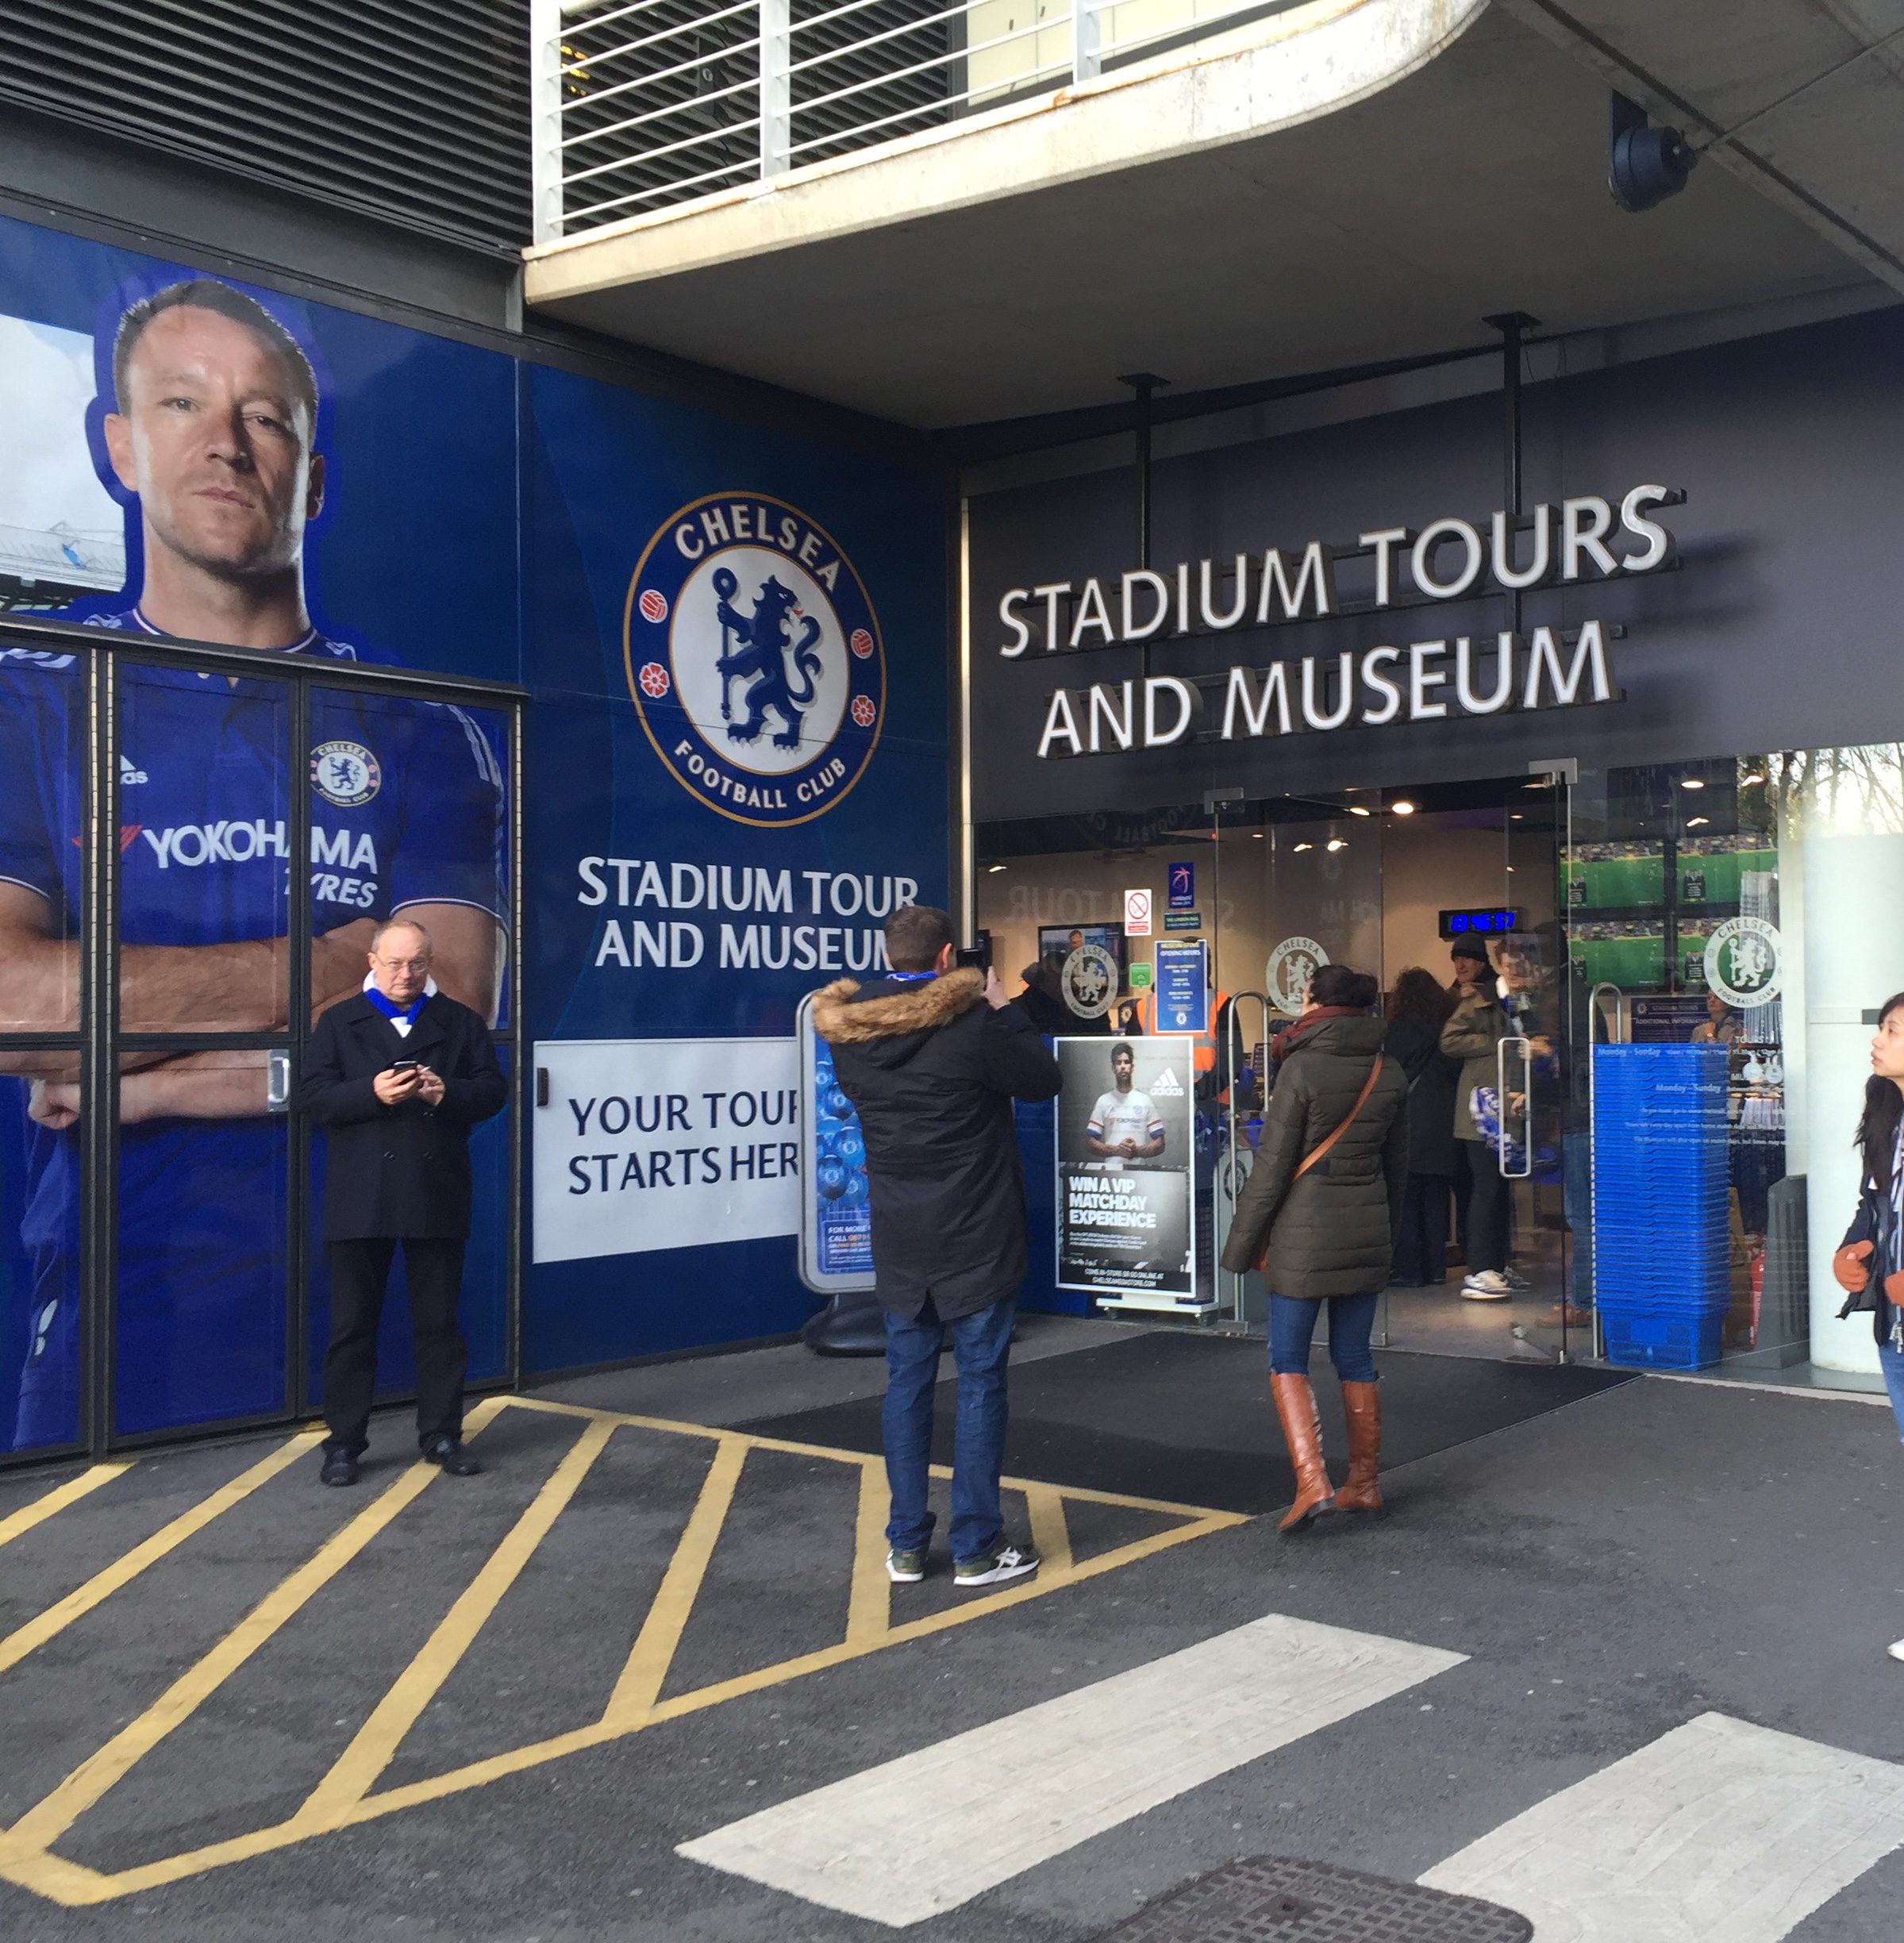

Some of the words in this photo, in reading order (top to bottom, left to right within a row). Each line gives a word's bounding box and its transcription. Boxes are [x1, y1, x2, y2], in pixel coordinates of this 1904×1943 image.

[675, 504, 842, 593] CHELSEA
[998, 541, 1331, 659] STADIUM
[1359, 483, 1675, 607] TOURS
[1037, 676, 1195, 759] AND
[1222, 620, 1613, 740] MUSEUM
[317, 744, 367, 760] CHELSEA
[674, 740, 787, 809] FOOTBALL
[797, 757, 846, 802] CLUB
[142, 819, 378, 875] YOKOHMA
[284, 868, 379, 907] RES
[578, 856, 794, 914] STADIUM
[802, 871, 919, 918] TOUR
[595, 919, 704, 968] AND
[1276, 938, 1319, 956] CHELSEA
[1717, 918, 1774, 938] CHELSEA
[1717, 987, 1754, 1003] FOOTBALL
[1151, 1087, 1184, 1096] adidas
[568, 1095, 693, 1136] YOUR
[568, 1146, 721, 1195] STARTS
[730, 1142, 798, 1181] HER
[1069, 1176, 1098, 1191] WIN
[1098, 1177, 1111, 1192] A
[1111, 1178, 1137, 1193] VIP
[1069, 1193, 1148, 1210] MATCHDAY
[1069, 1209, 1156, 1228] EXPERIENCE
